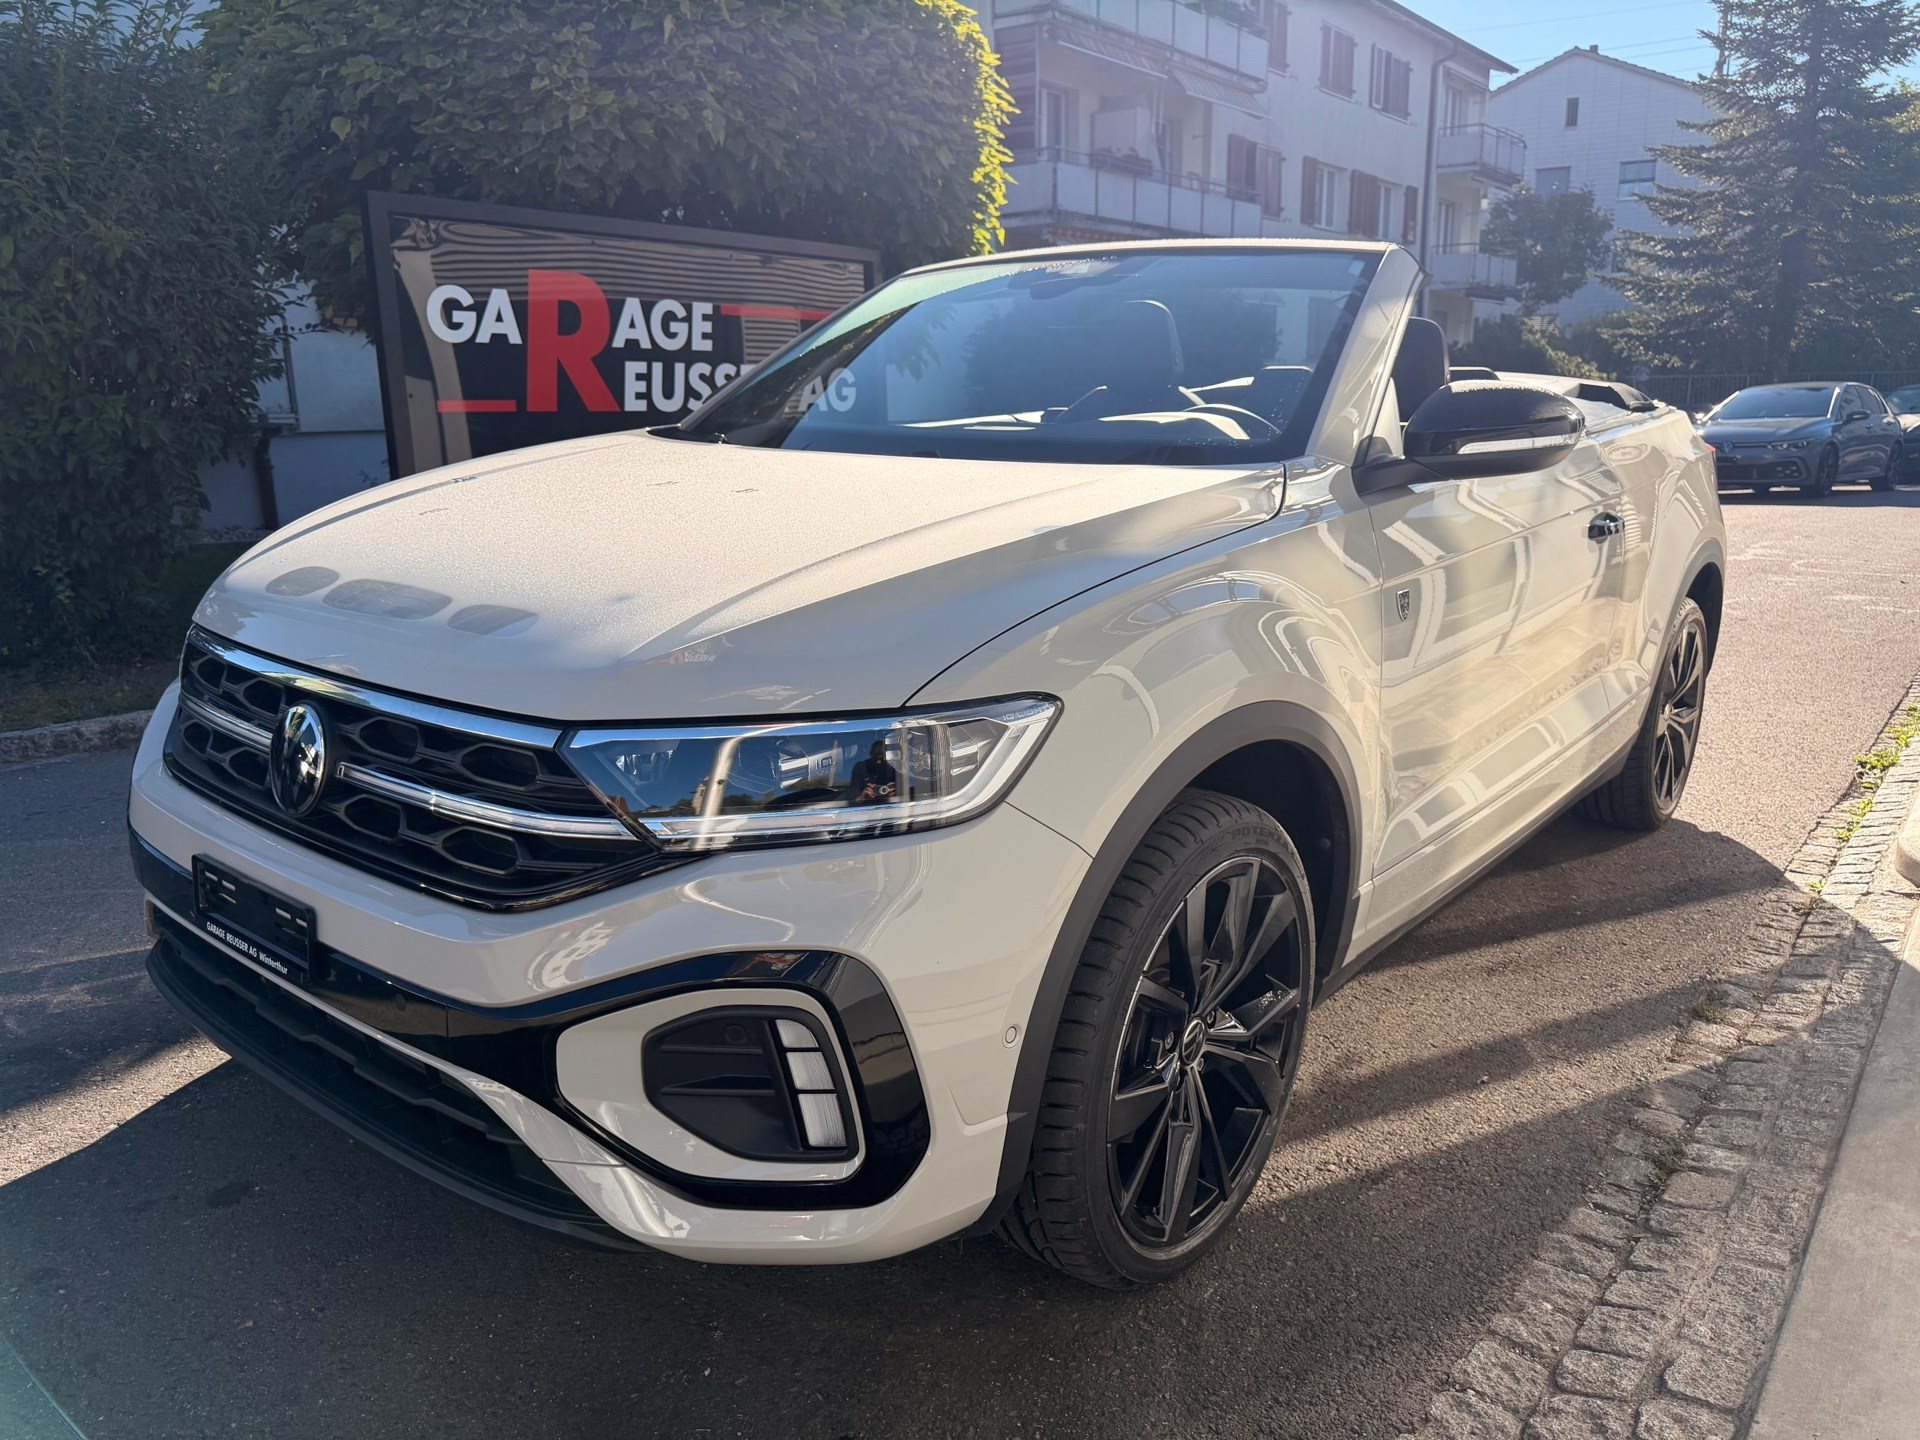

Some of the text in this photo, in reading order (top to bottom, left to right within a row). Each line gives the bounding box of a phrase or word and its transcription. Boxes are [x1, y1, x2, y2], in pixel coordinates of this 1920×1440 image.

[798, 367, 857, 412] AG
[206, 921, 288, 975] GARAGE REUSSER AG Winterthur
